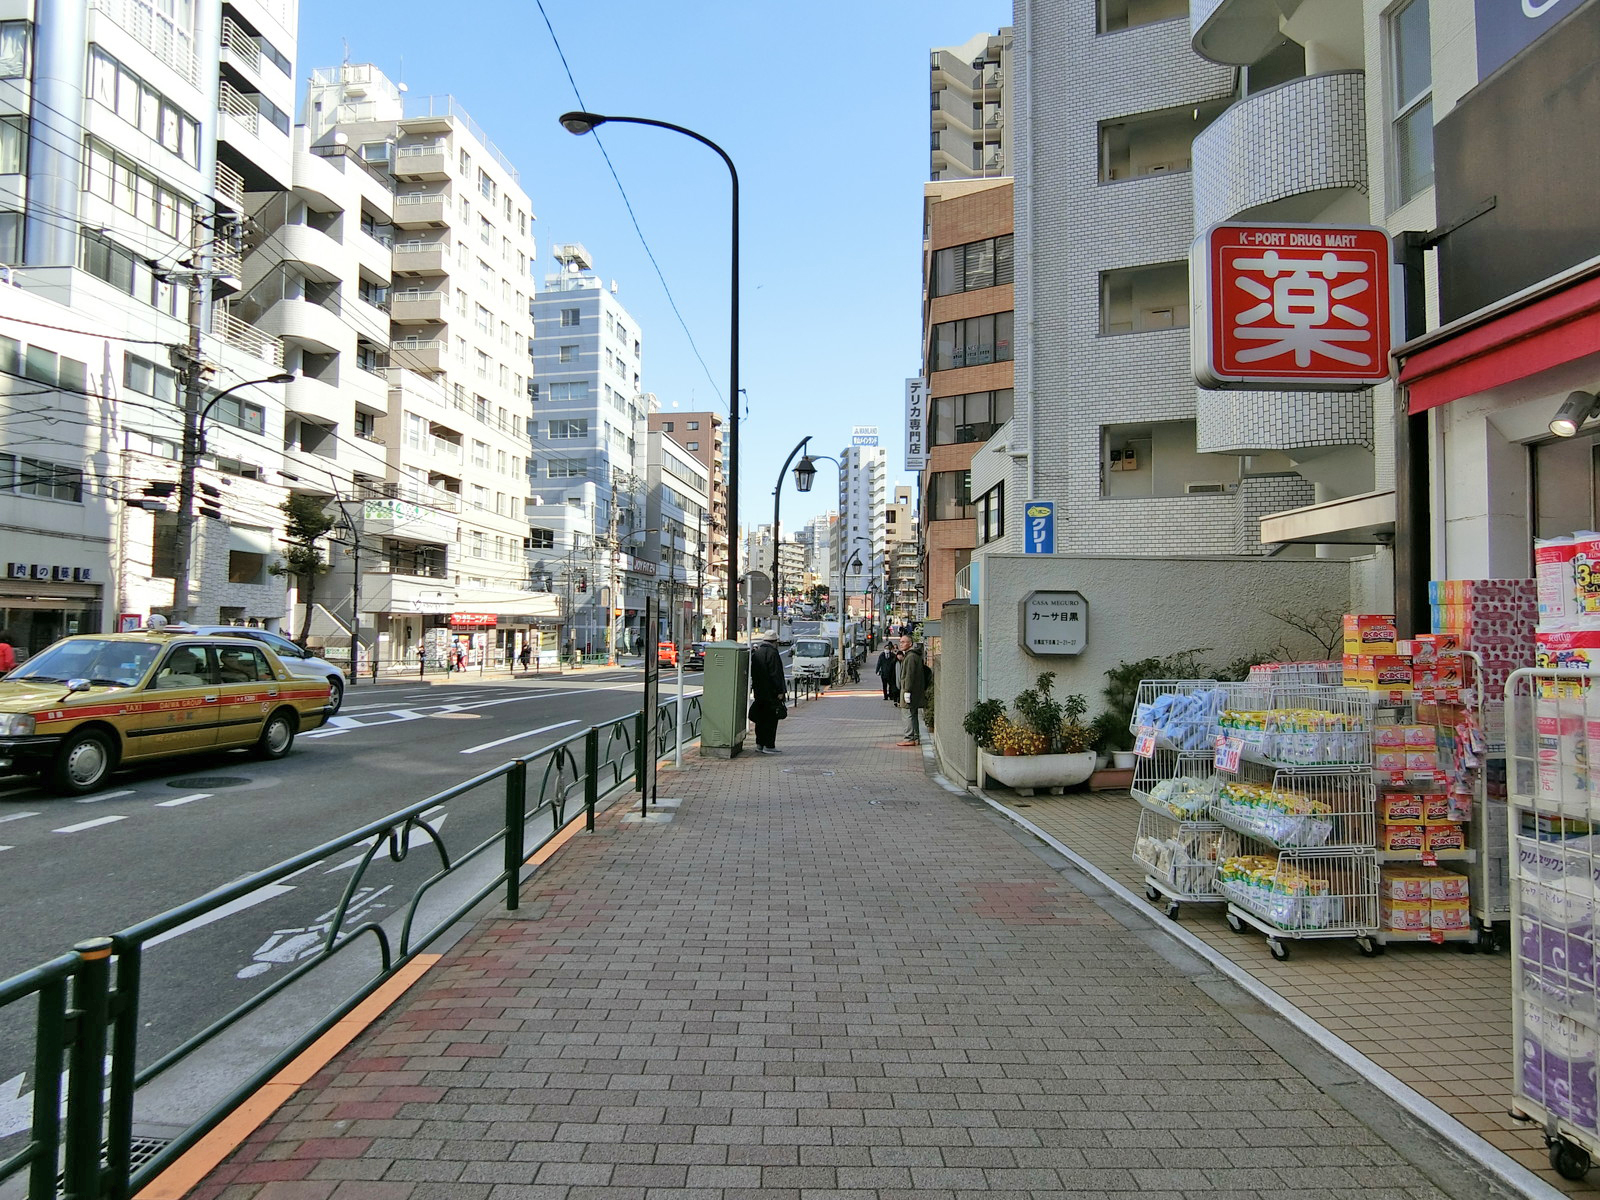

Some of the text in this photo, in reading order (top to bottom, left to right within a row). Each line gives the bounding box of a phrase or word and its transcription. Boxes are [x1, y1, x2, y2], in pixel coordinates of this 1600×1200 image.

[1239, 232, 1357, 248] K-PORT DRUG MART
[1232, 250, 1372, 368] 薬
[909, 382, 922, 454] デリカ専門店
[1032, 612, 1079, 622] カーサ目黒
[125, 704, 142, 712] TAXI
